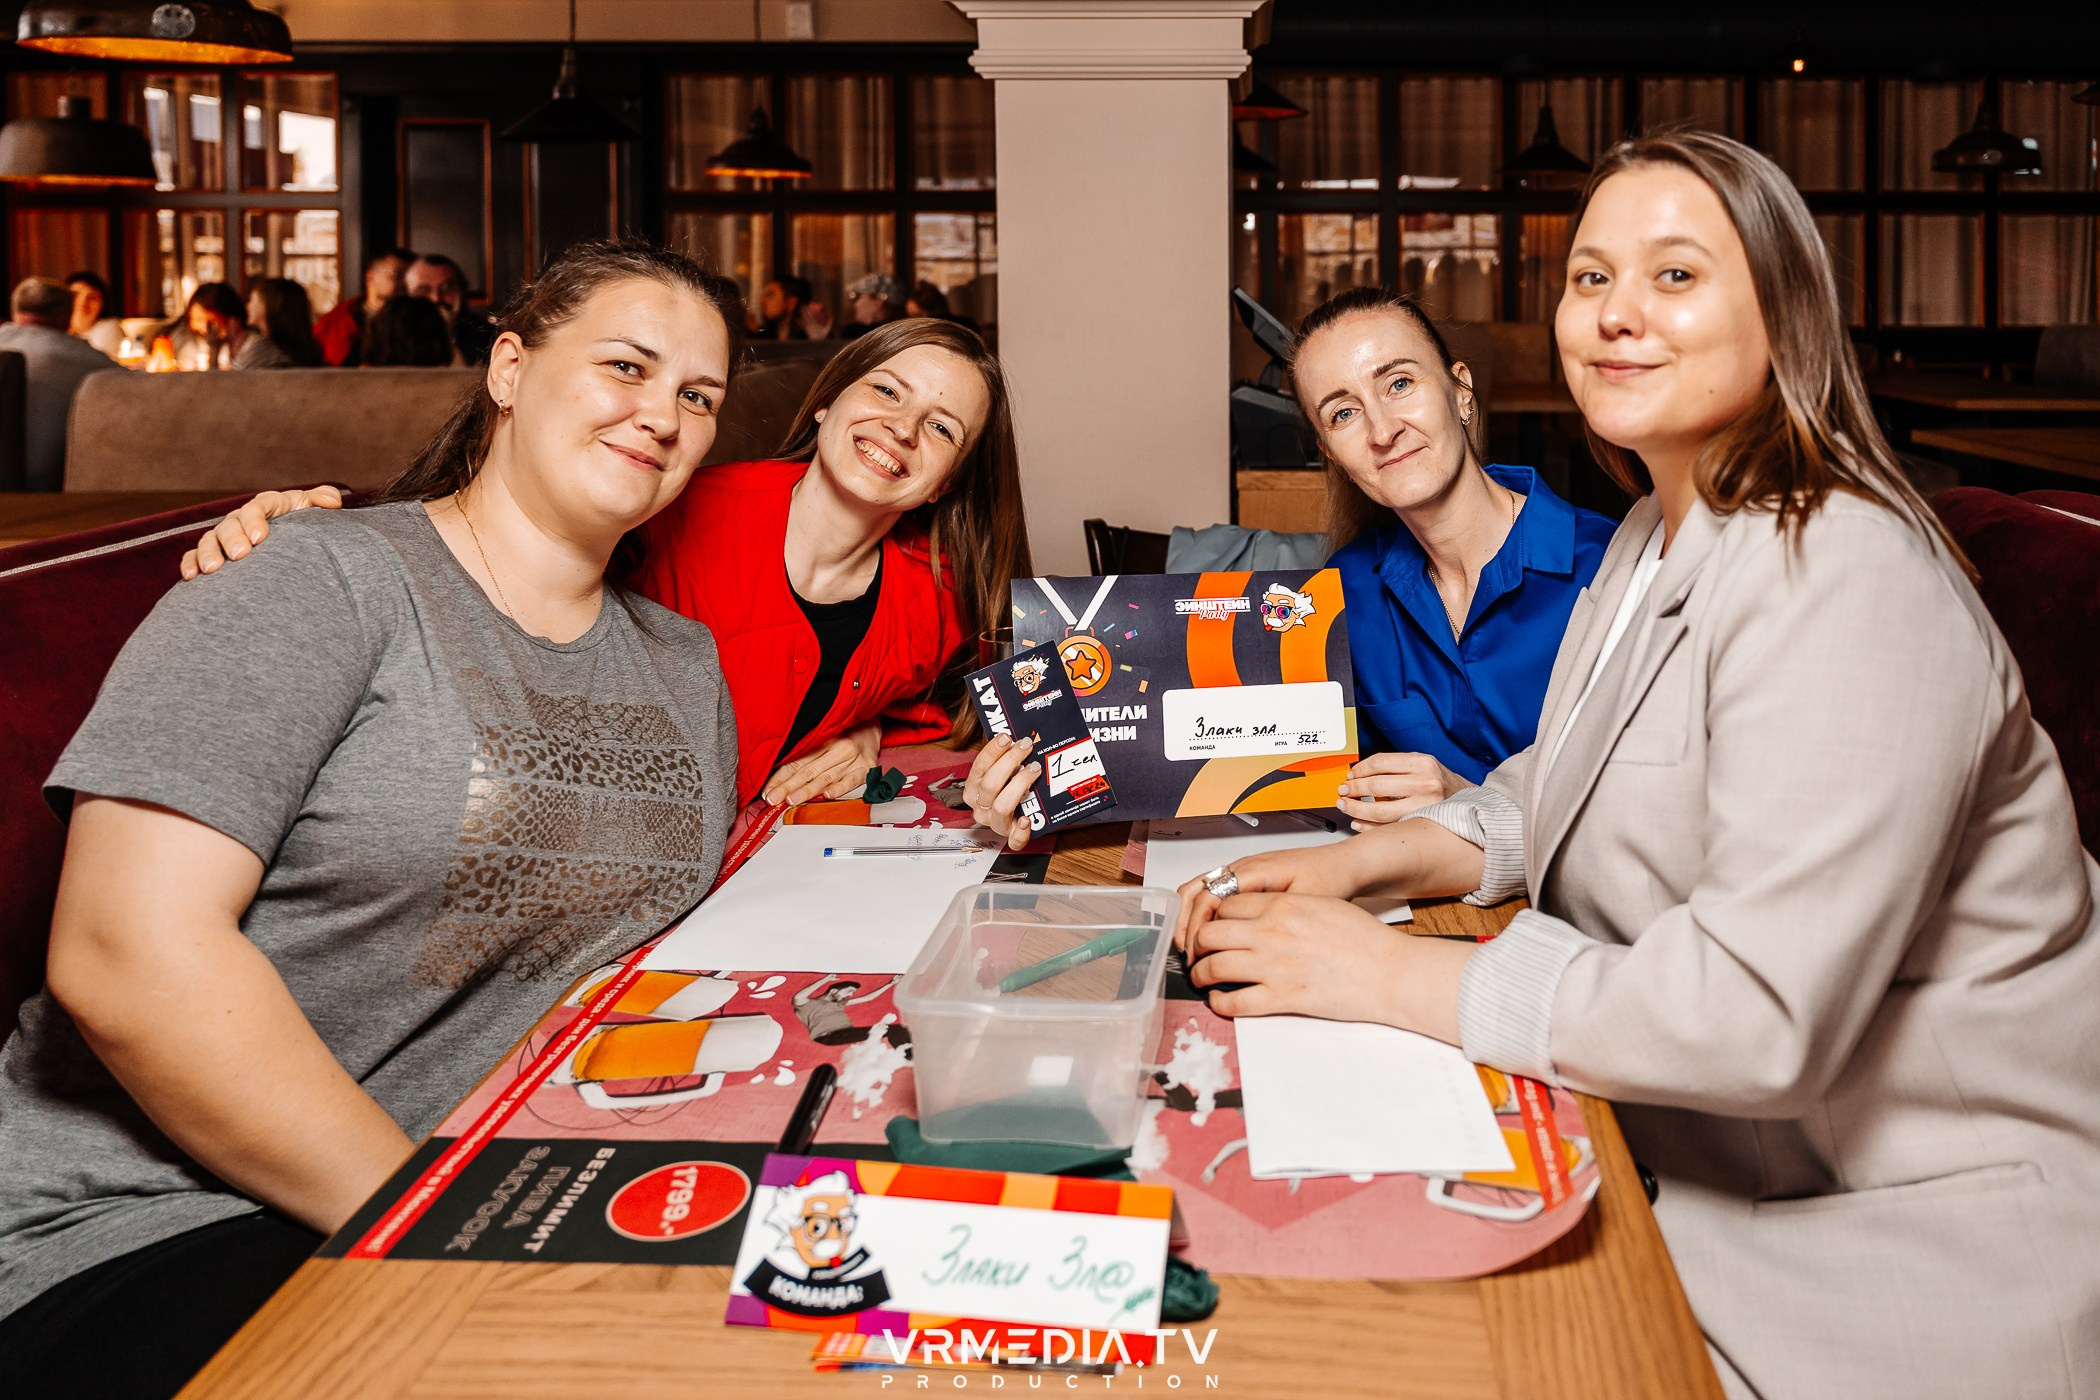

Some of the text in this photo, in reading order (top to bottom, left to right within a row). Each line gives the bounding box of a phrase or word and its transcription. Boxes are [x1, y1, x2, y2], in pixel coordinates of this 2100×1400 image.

[1199, 609, 1230, 621] Party
[1088, 726, 1137, 742] ИЗНИ
[1296, 734, 1320, 744] 522
[973, 677, 1046, 831] СЕИКАТ
[1052, 754, 1075, 778] 1
[591, 988, 619, 1014] среда
[571, 1018, 591, 1034] дни
[508, 1034, 578, 1098] безграничных
[444, 1145, 552, 1252] ЗАКУСОК
[502, 1166, 572, 1230] ПИВА
[522, 1147, 617, 1254] БЕЗЛИМИТ
